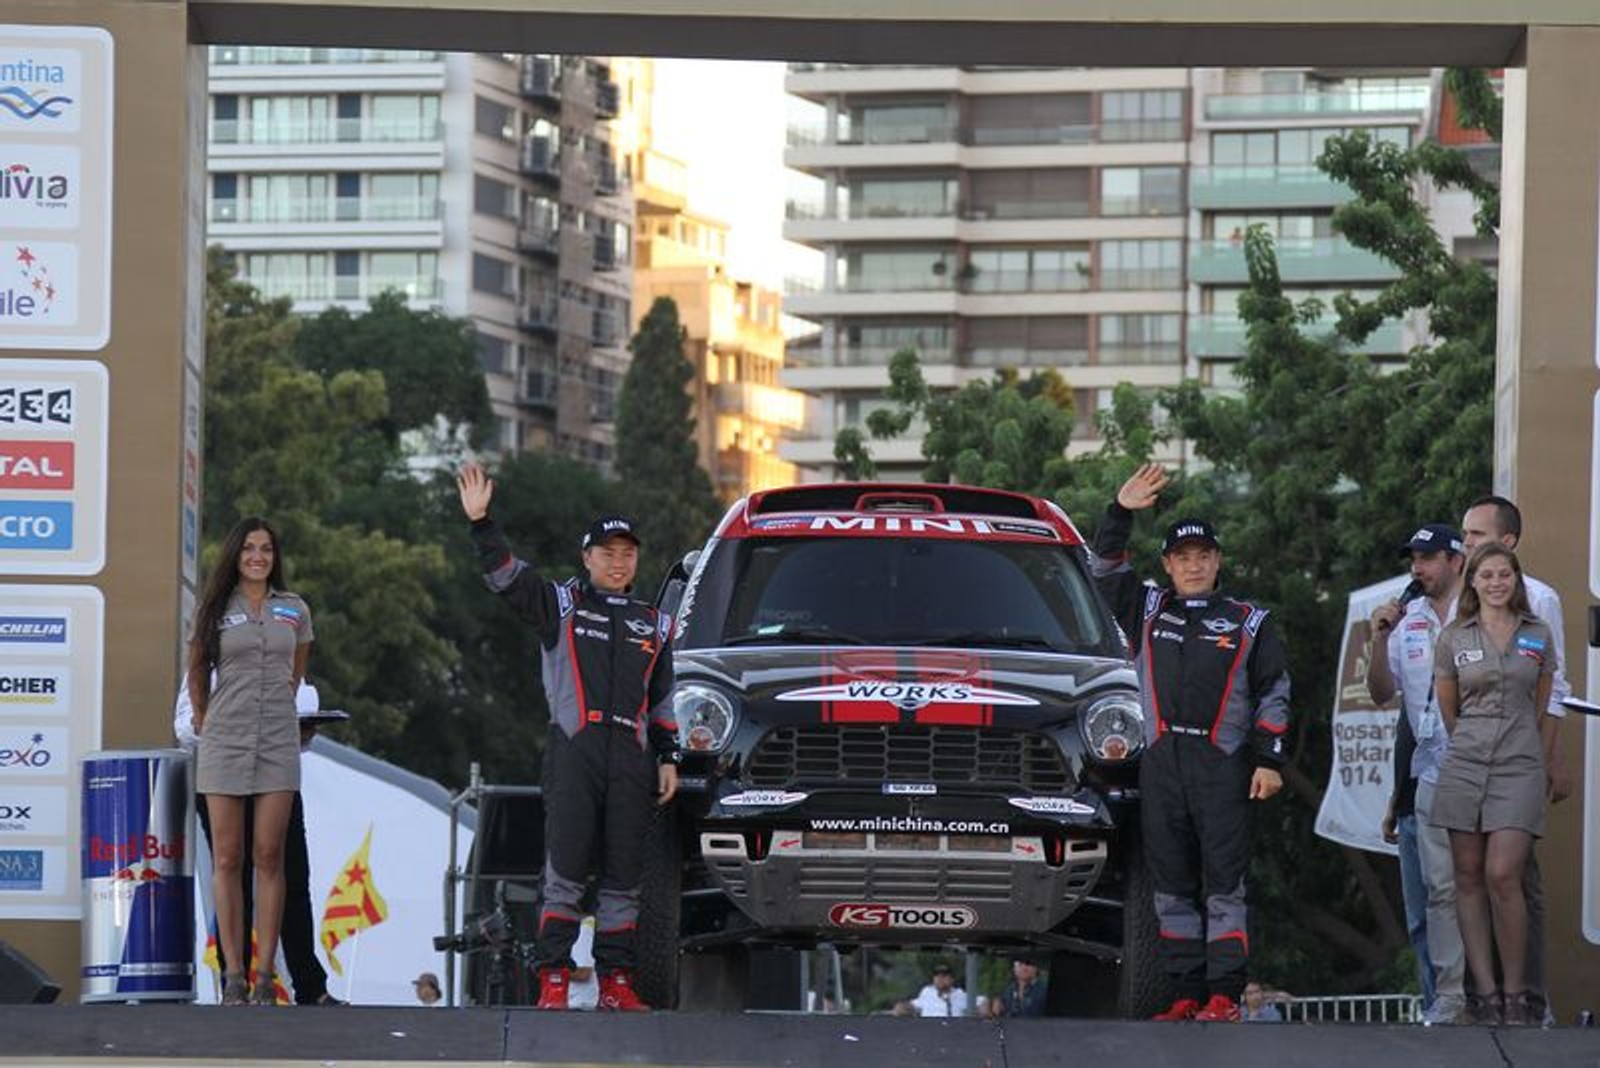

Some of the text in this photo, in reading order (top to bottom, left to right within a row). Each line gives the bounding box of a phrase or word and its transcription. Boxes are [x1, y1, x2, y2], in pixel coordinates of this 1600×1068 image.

[1, 515, 54, 537] cro
[810, 516, 991, 533] MINI
[0, 677, 56, 693] CHER
[848, 685, 970, 699] WORKS
[1340, 766, 1383, 786] 014
[810, 816, 1010, 833] www.minichina.com.cn
[840, 907, 965, 925] KS TOOLS
